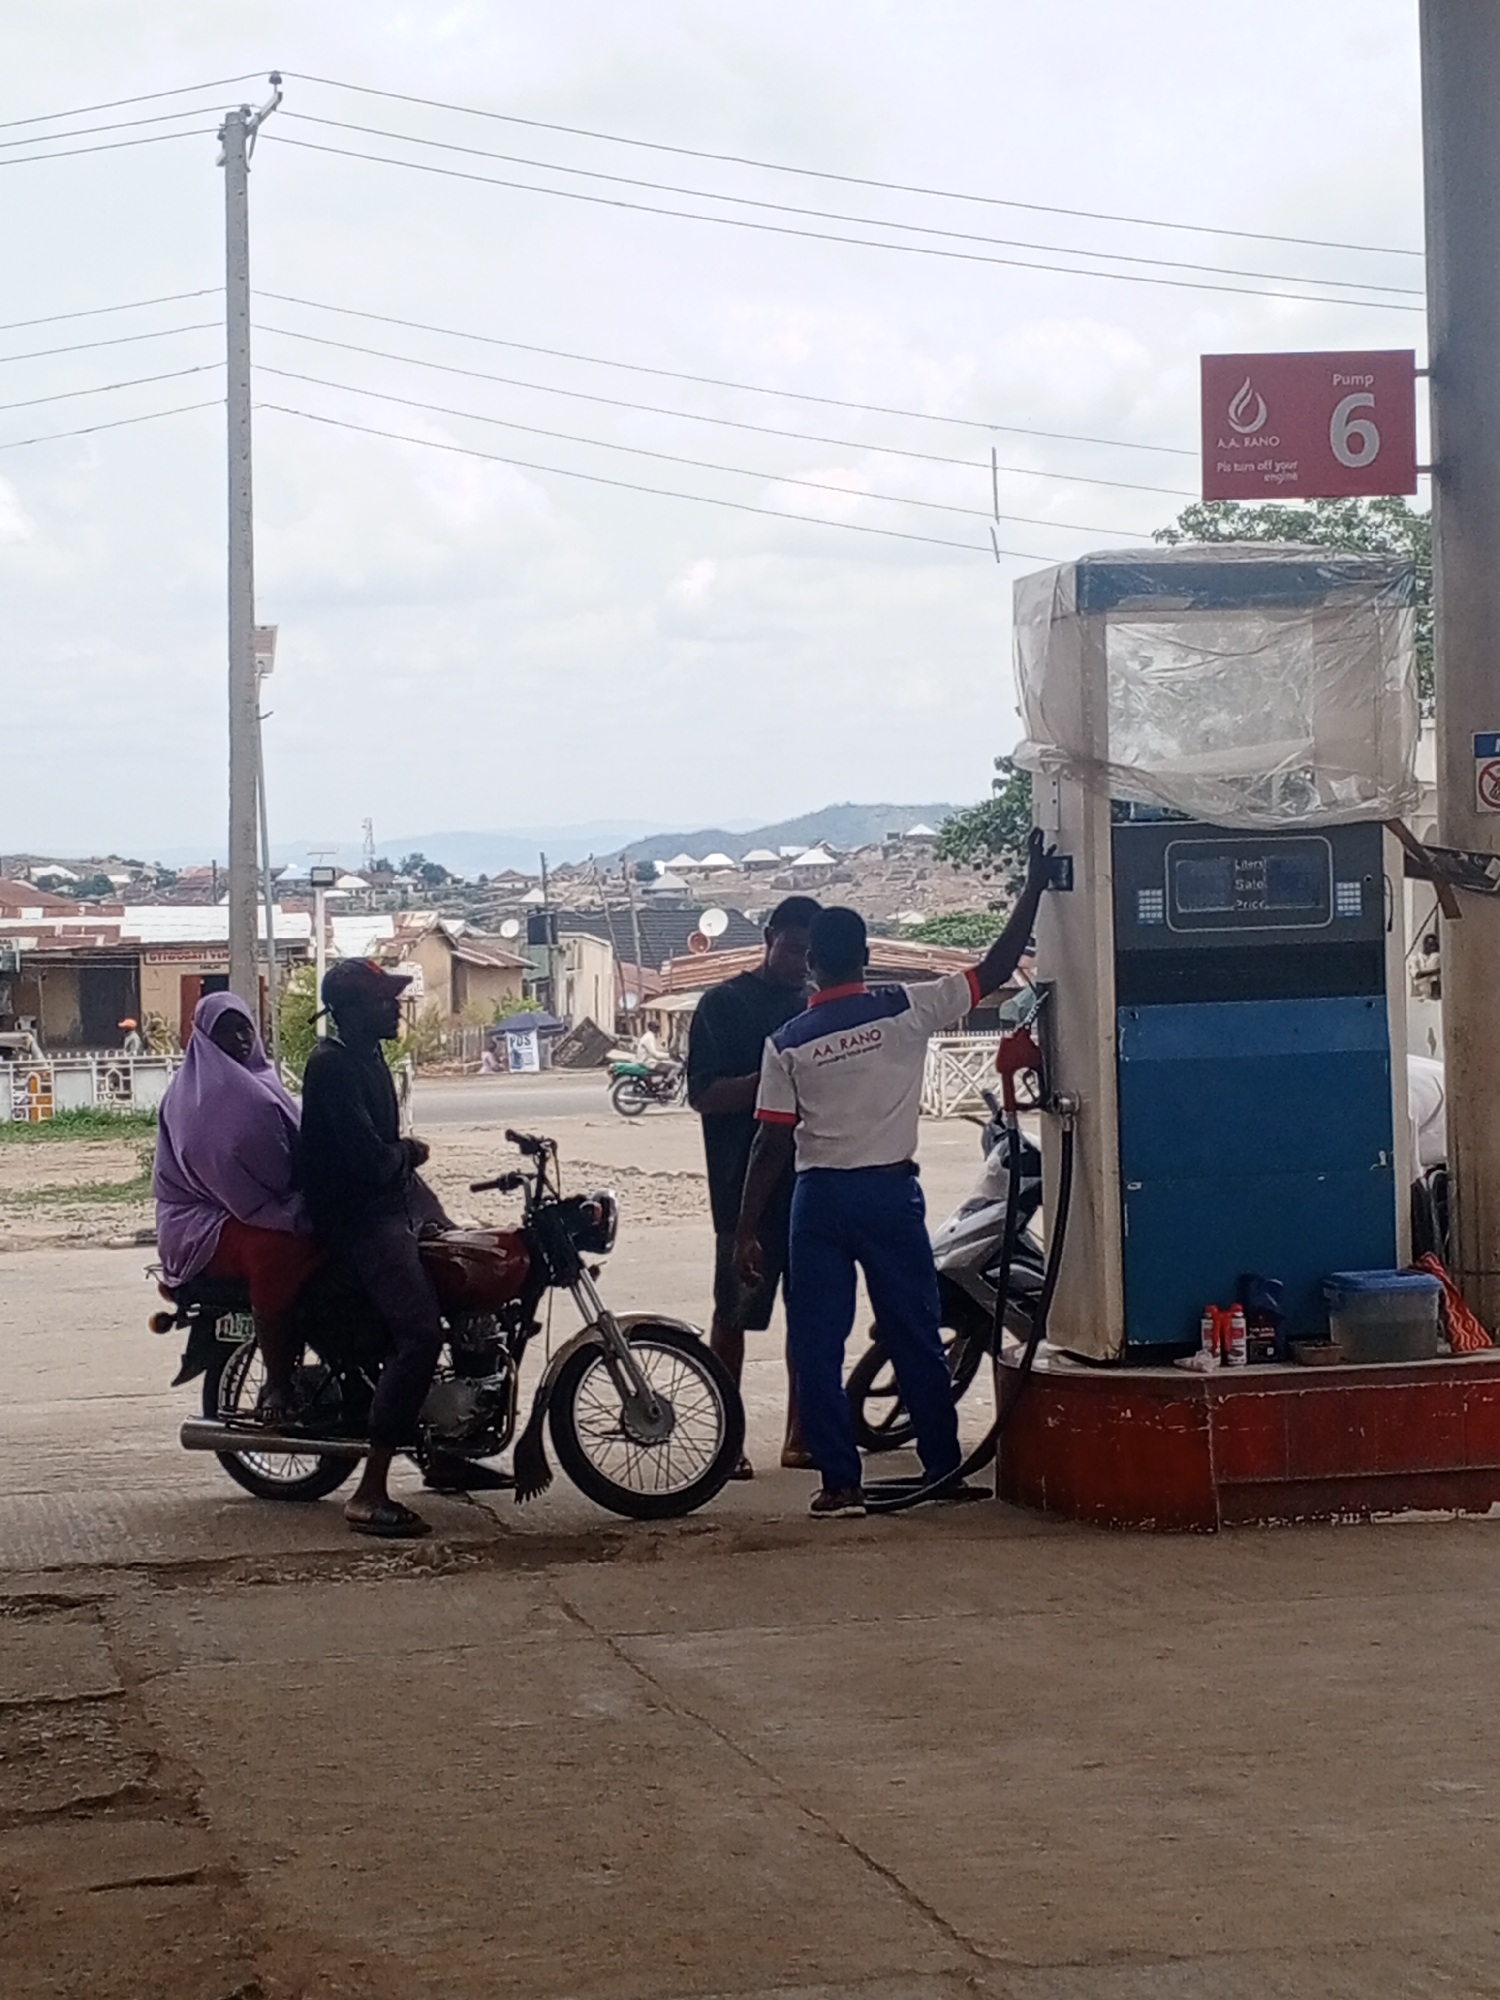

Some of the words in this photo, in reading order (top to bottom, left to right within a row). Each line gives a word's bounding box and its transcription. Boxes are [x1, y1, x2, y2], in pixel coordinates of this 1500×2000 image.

[1332, 373, 1375, 387] Pump
[1329, 392, 1380, 468] 6
[1244, 435, 1280, 449] RANO
[1257, 459, 1273, 471] off
[1274, 460, 1299, 474] your
[1263, 472, 1299, 485] engine
[510, 1035, 532, 1048] POS
[839, 1028, 882, 1051] RANO
